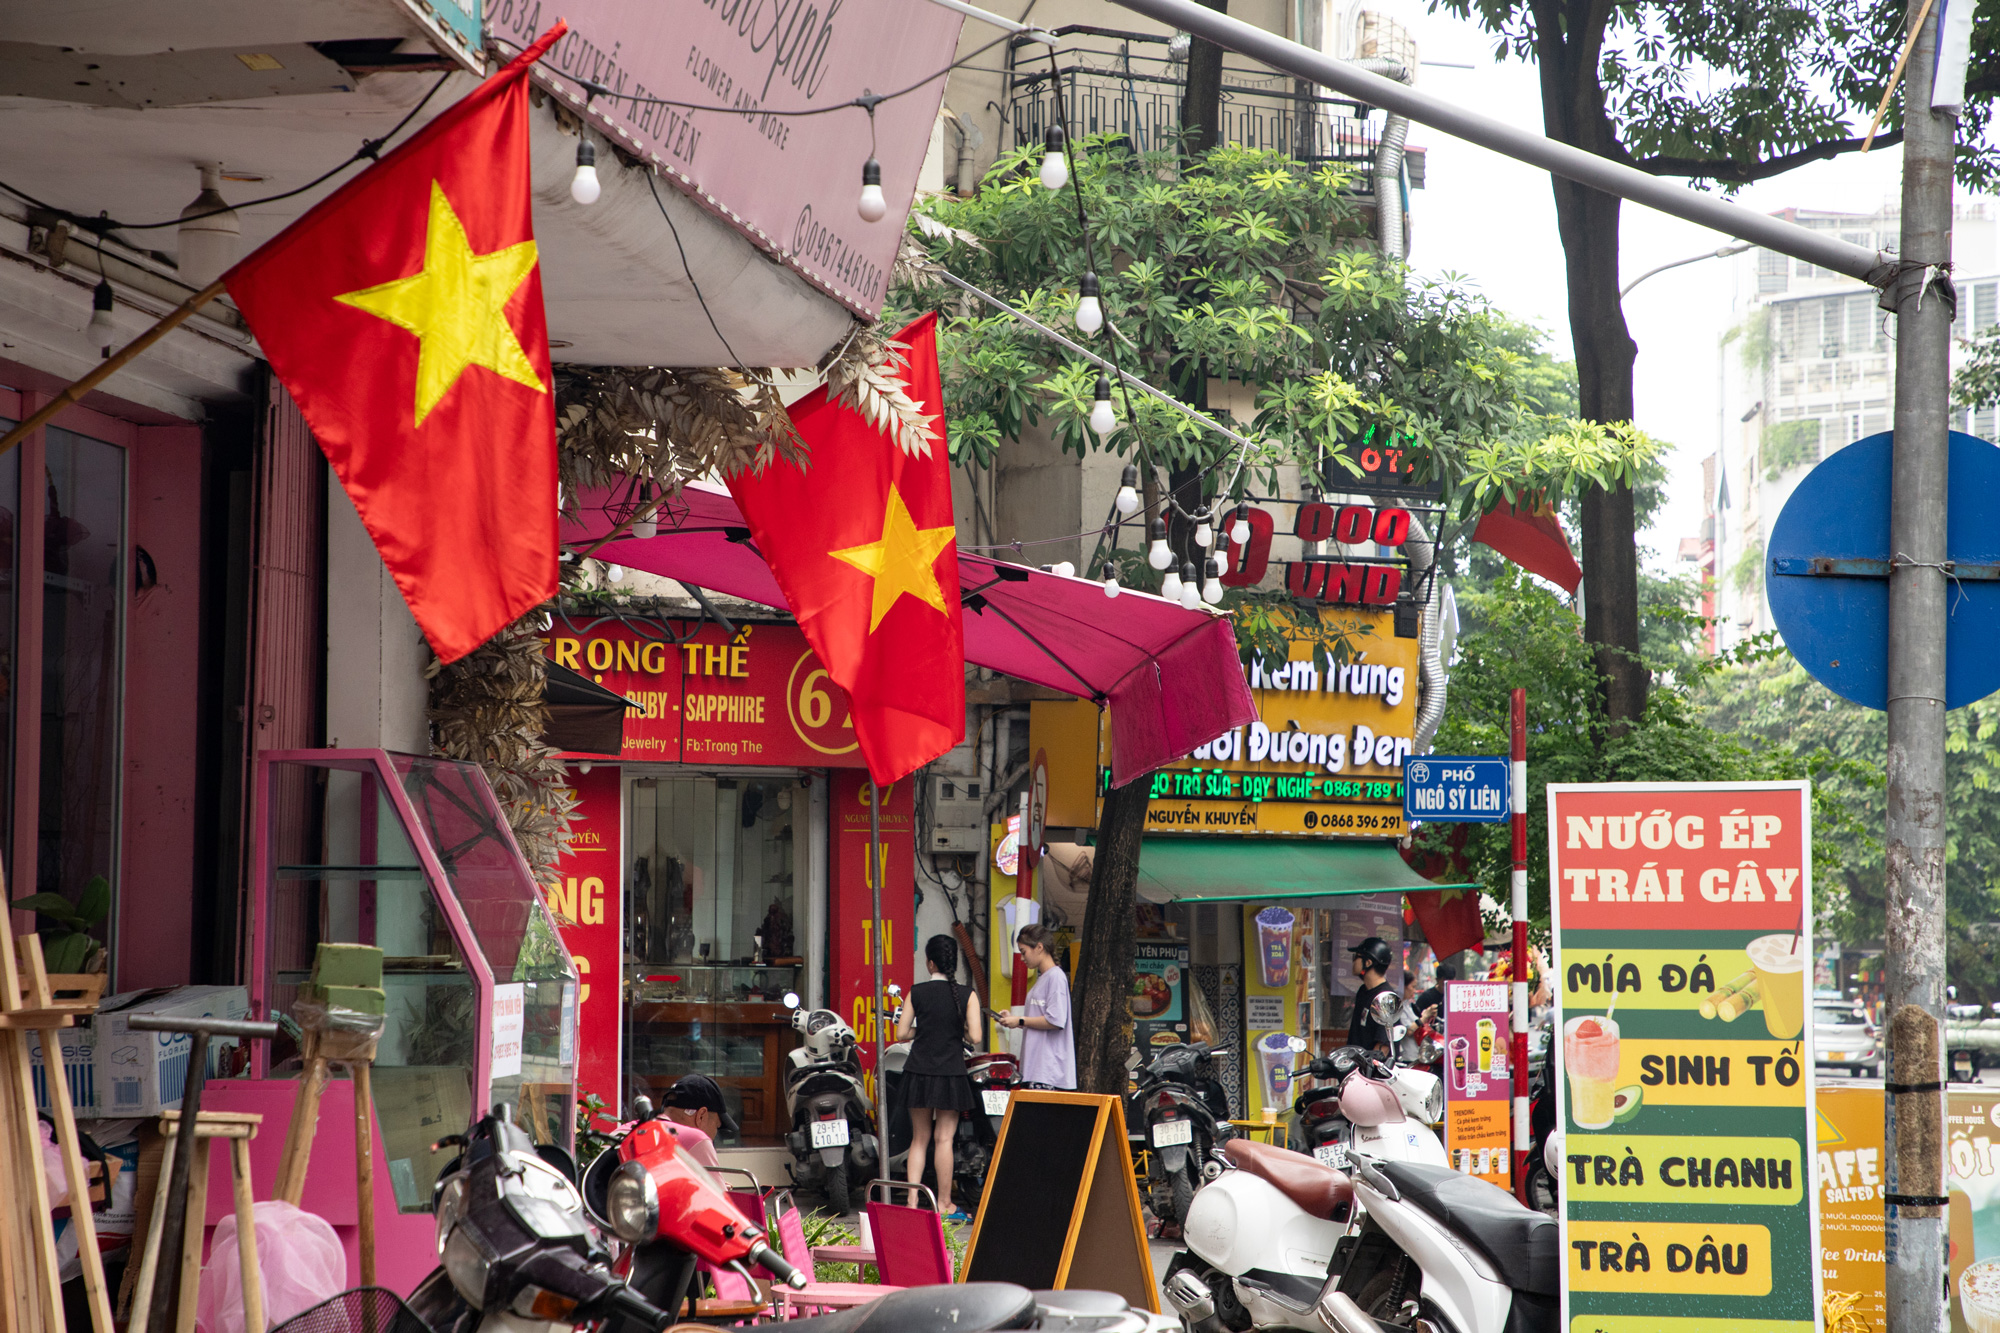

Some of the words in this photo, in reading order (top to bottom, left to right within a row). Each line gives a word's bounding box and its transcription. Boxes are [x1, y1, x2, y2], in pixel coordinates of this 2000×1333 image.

[685, 45, 732, 103] FLOWER
[733, 87, 758, 124] AND
[759, 109, 790, 150] MORE
[627, 83, 701, 166] KHUYẾN
[805, 220, 882, 303] 0967446186
[1298, 502, 1410, 547] 000
[682, 624, 753, 678] THỂ
[625, 690, 667, 719] RUBY
[686, 693, 765, 723] SAPPHIRE
[622, 736, 667, 752] Jewelry
[741, 740, 763, 753] The
[1248, 720, 1346, 773] Đường
[1353, 725, 1412, 766] Đen
[1323, 780, 1361, 797] 0868
[1365, 781, 1391, 798] 789
[1441, 764, 1476, 782] PHỐ
[1148, 803, 1200, 824] NGUYỄN
[1205, 805, 1256, 825] KHUYẾN
[1415, 783, 1445, 810] NGÔ
[1448, 784, 1467, 810] SỸ
[1470, 784, 1500, 810] LIÊN
[1321, 814, 1353, 829] 0868
[1356, 815, 1379, 829] 396
[1381, 816, 1400, 830] 291
[1566, 809, 1705, 850] NƯỚC
[1720, 808, 1782, 849] ÉP
[1564, 862, 1685, 902] TRÁI
[1699, 860, 1800, 903] CÂY
[1567, 953, 1642, 993] MÍA
[1658, 954, 1716, 993] ĐÁ
[1640, 1055, 1730, 1086] SINH
[1746, 1041, 1801, 1087] TỐ
[816, 1122, 842, 1134] 29-F1
[1964, 1116, 1985, 1125] HOUSE
[1567, 1146, 1644, 1187] TRÀ
[1659, 1156, 1793, 1190] CHANH
[1826, 1186, 1875, 1204] SALTED
[1571, 1232, 1650, 1273] TRÀ
[1666, 1234, 1748, 1275] DÂU
